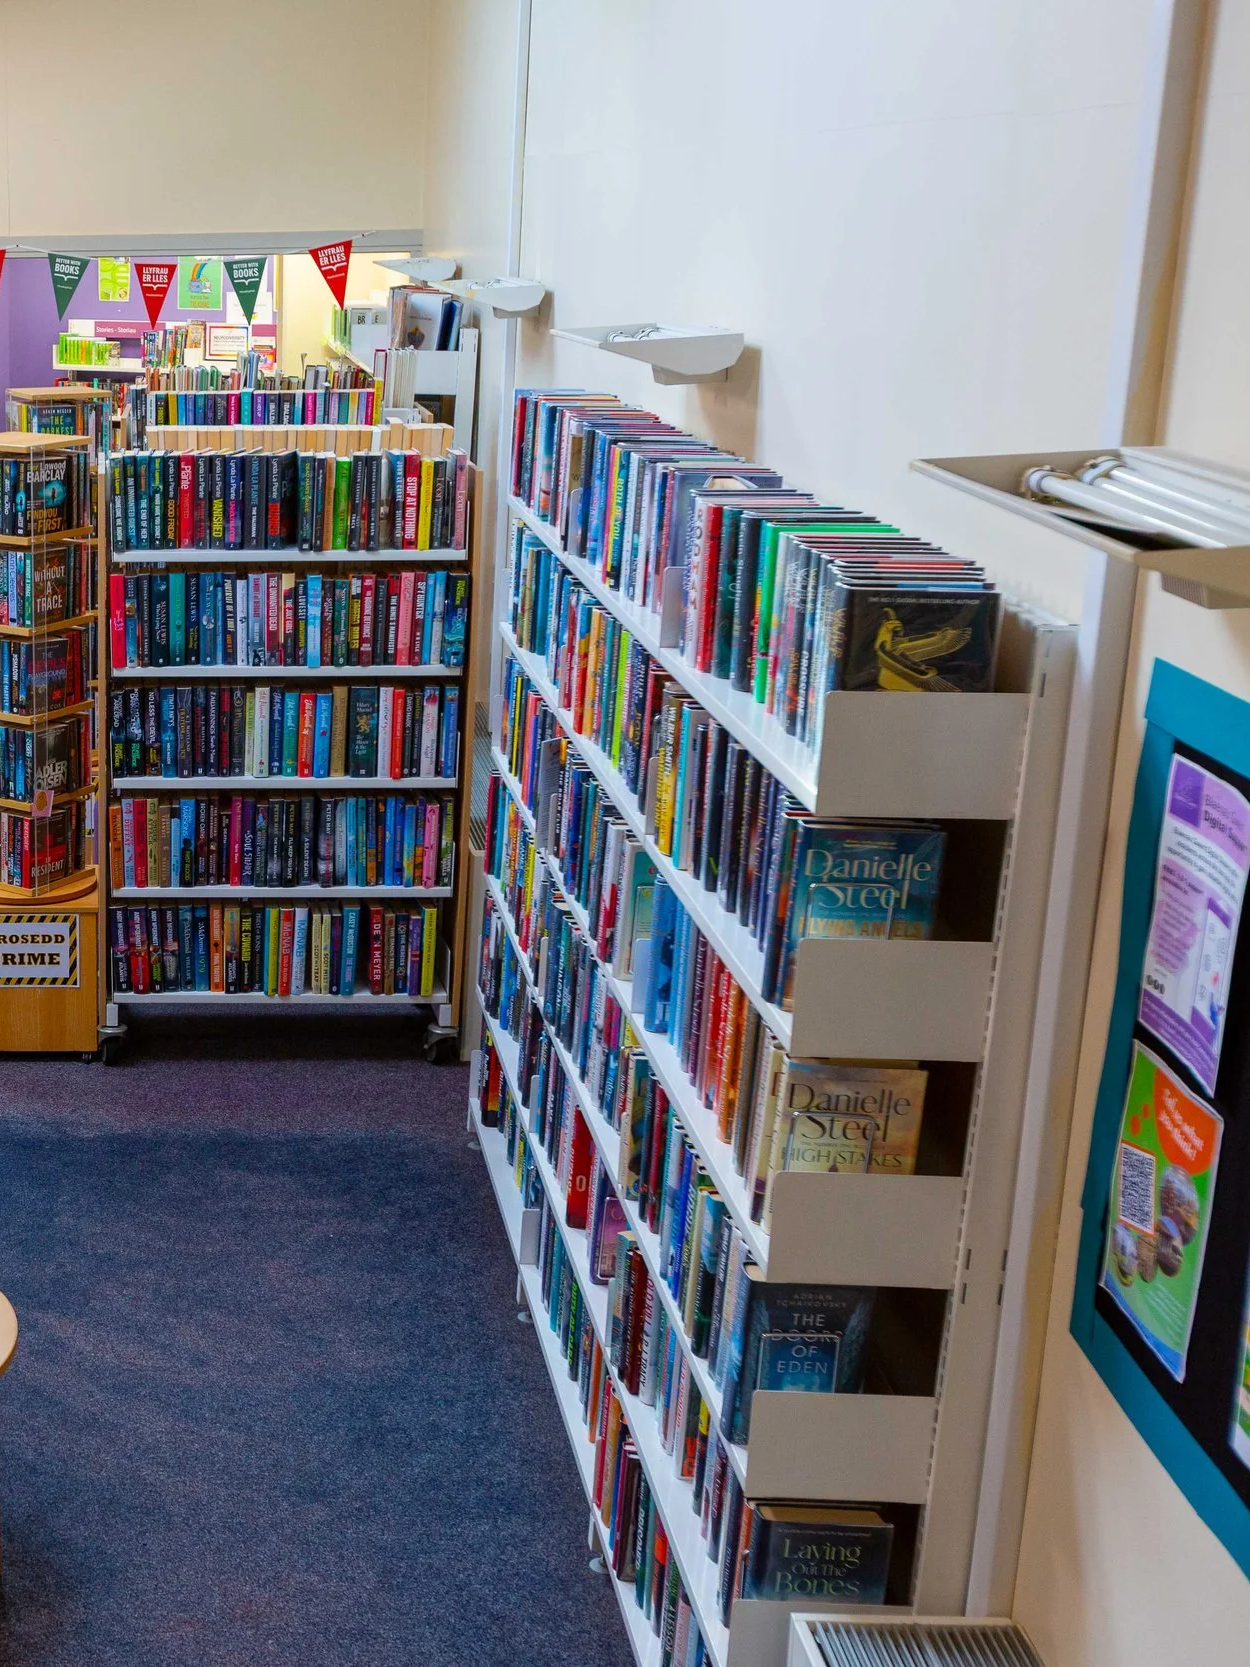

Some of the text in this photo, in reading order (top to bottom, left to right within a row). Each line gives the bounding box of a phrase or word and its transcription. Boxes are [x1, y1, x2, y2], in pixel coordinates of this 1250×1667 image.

[318, 245, 344, 257] LLYFRAU
[320, 253, 346, 265] ER LLES
[54, 263, 80, 275] BOOKS
[142, 266, 169, 275] LLYFRAU
[233, 268, 259, 278] BOOKS
[142, 274, 168, 283] ER LLES
[96, 326, 115, 334] Stories
[51, 415, 64, 424] THE
[40, 461, 66, 470] Linwood
[27, 470, 66, 483] BARCLAY
[215, 474, 222, 482] La
[434, 477, 445, 502] Leon
[616, 478, 624, 504] BOTH
[405, 476, 417, 539] STOP AT NOTHING
[457, 490, 465, 511] Leon
[26, 507, 57, 520] FIND YOU
[212, 498, 222, 538] VANISHED
[614, 506, 622, 519] OF
[38, 517, 62, 530] FIRST
[9, 553, 17, 603] Ann Cleeves
[34, 566, 65, 580] WITHOUT
[46, 582, 53, 593] A
[37, 595, 63, 612] TRACE
[269, 577, 277, 631] THE UNWANTED DEAD
[28, 669, 66, 681] PLAYGROUND
[795, 650, 810, 716] CROSSFIRE
[148, 692, 155, 701] NO
[36, 762, 68, 779] ADLER
[35, 776, 68, 792] OLSEN
[31, 859, 64, 879] RESIDENT
[804, 849, 933, 882] Danielle
[818, 881, 908, 910] Steel
[798, 918, 925, 939] FLYING ANGELS
[241, 918, 252, 961] THE COWARD
[373, 924, 381, 980] DEN MEYER
[787, 1083, 911, 1115] Danielle
[801, 1114, 889, 1143] Steel
[780, 1148, 903, 1168] HIGH STAKES
[776, 1298, 847, 1309] TCHAIKOVSKY
[793, 1292, 833, 1302] ADRIAN
[792, 1313, 826, 1327] THE
[791, 1344, 819, 1358] OF
[776, 1360, 828, 1375] EDEN
[782, 1538, 863, 1569] Laying
[793, 1563, 847, 1577] Out The
[773, 1571, 860, 1597] Bones
